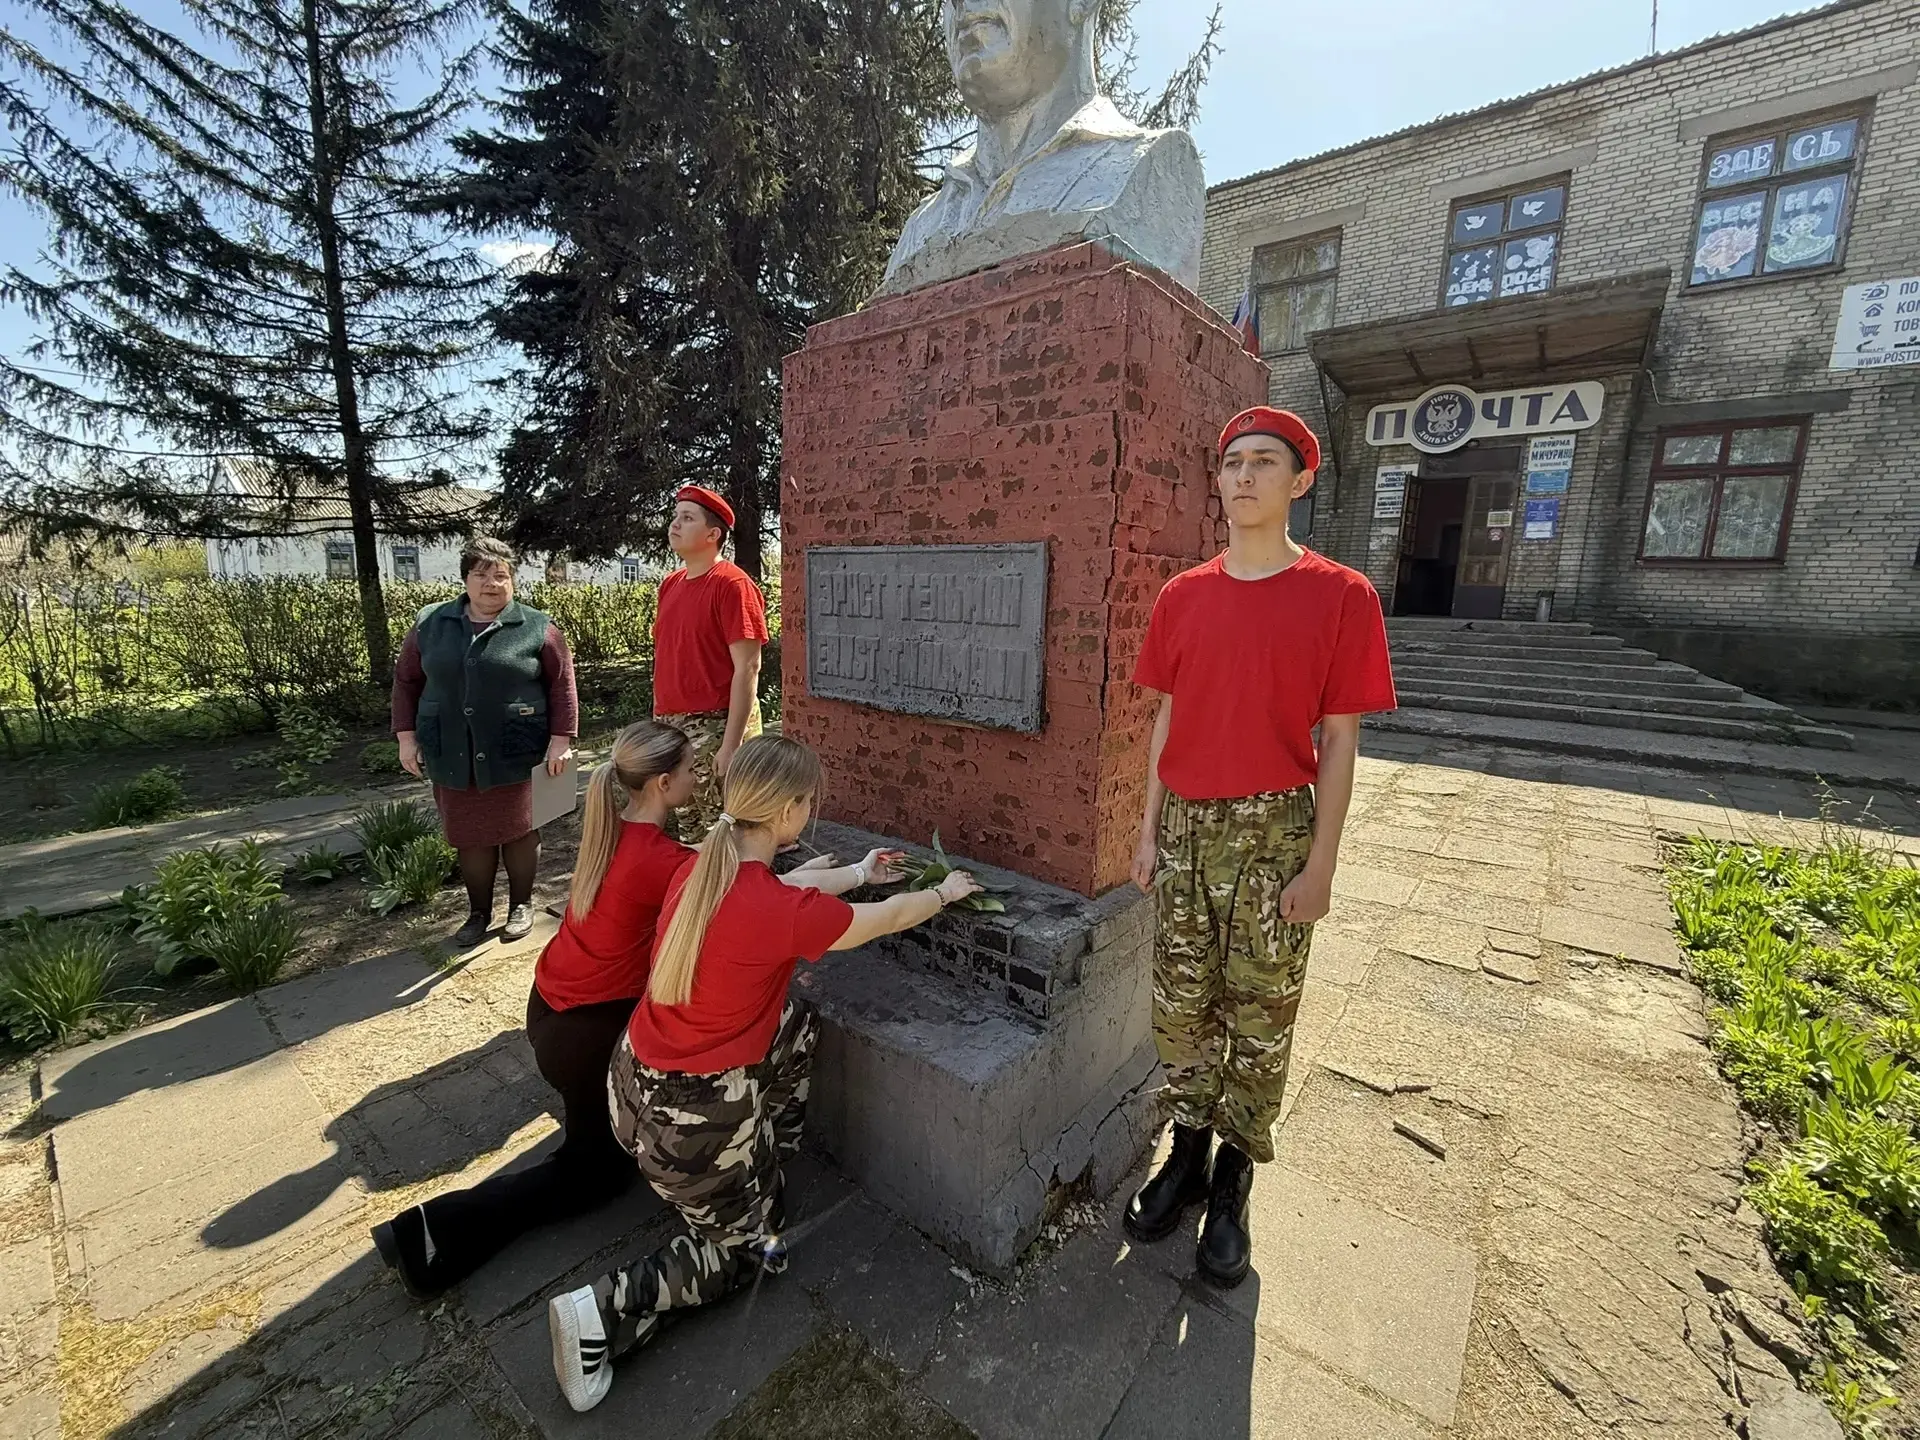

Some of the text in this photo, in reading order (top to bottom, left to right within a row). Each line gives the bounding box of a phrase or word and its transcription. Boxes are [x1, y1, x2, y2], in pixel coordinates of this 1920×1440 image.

[1430, 394, 1460, 405] ПОЧТА
[1418, 427, 1466, 444] ДОНБАССА
[1533, 440, 1571, 449] АГРОФИРМА
[819, 572, 886, 619] ЭРНСТ
